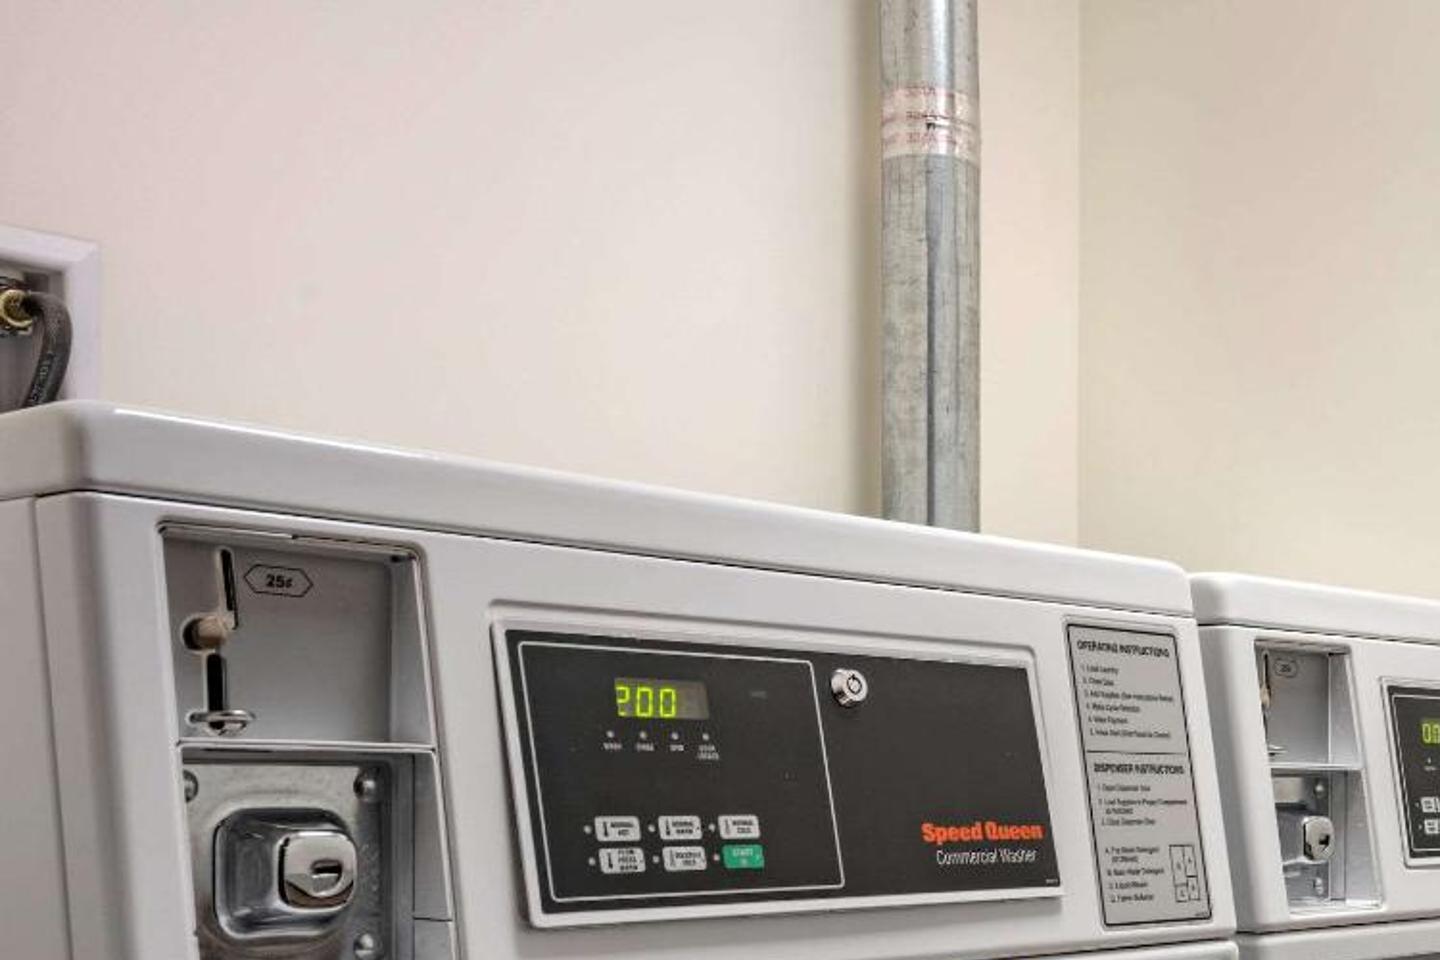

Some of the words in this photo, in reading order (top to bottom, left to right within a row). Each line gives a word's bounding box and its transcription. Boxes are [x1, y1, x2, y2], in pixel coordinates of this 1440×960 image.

[921, 821, 984, 846] Speed
[984, 821, 1046, 841] Queen
[936, 848, 998, 865] Commercial
[999, 848, 1037, 864] Washer
